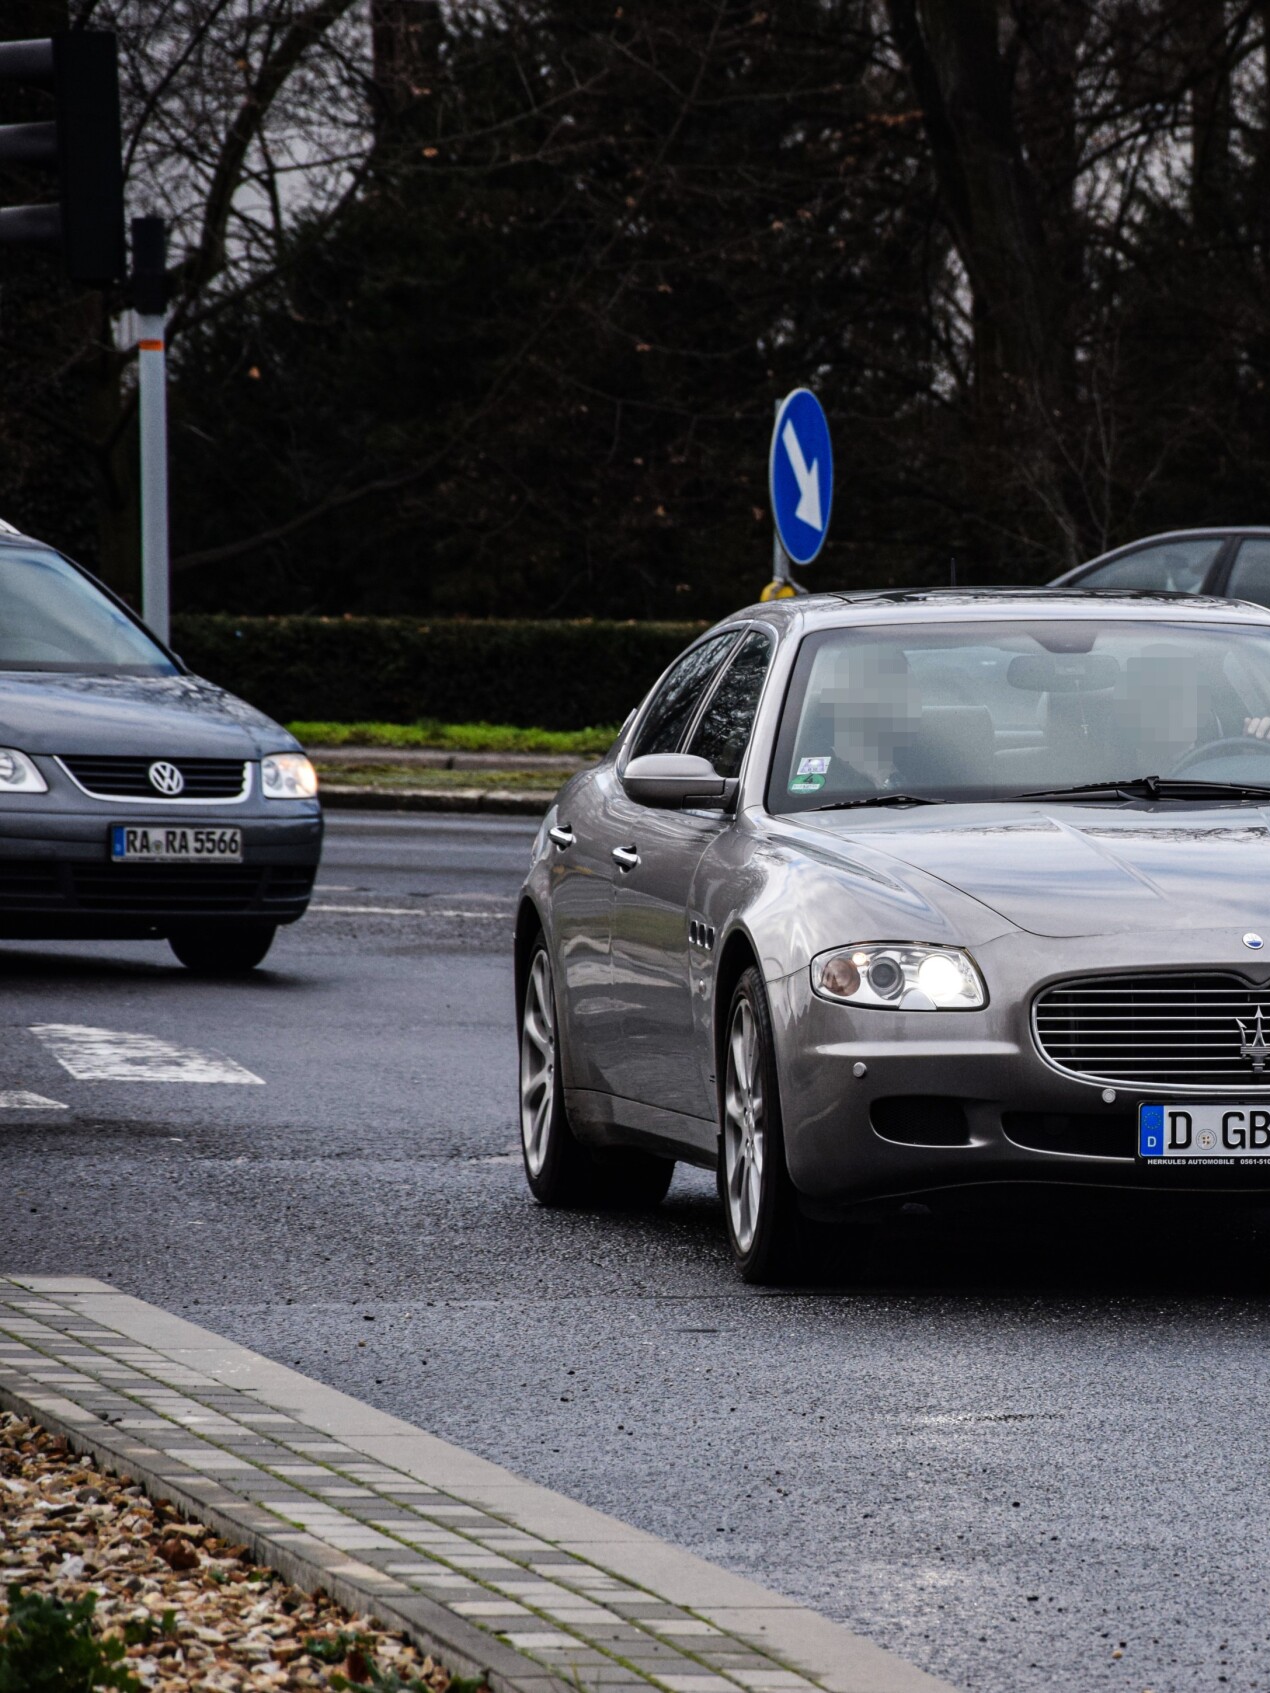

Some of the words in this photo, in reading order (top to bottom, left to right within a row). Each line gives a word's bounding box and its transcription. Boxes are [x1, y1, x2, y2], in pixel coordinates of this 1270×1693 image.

[126, 829, 150, 854] RA
[165, 830, 189, 854] RA
[194, 830, 239, 854] 5566
[1168, 1111, 1192, 1149] D
[1147, 1136, 1157, 1148] D
[1147, 1158, 1186, 1166] HERKULES
[1188, 1158, 1235, 1166] AUTOMOBILE
